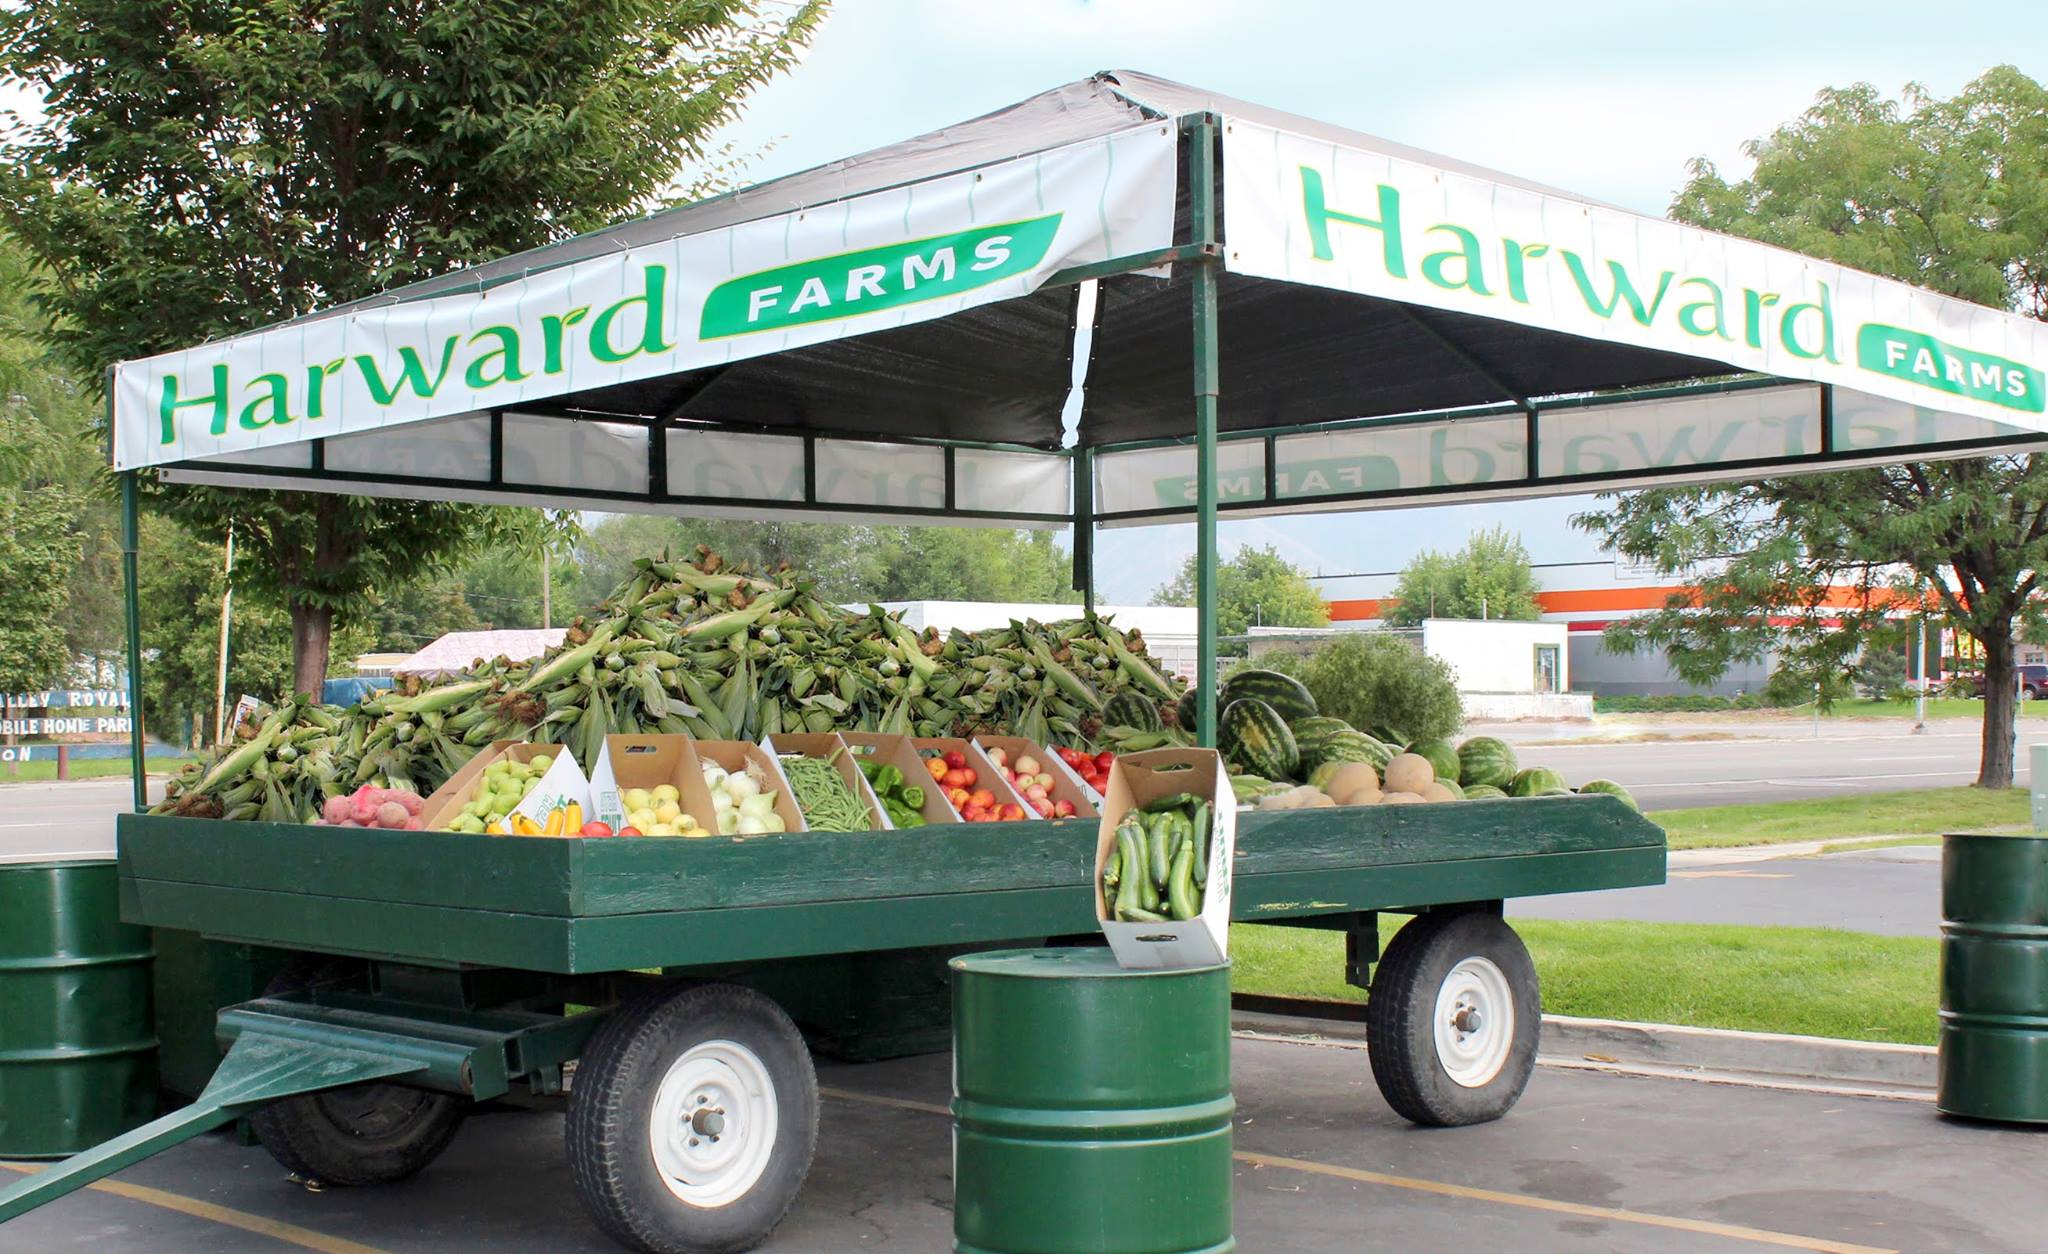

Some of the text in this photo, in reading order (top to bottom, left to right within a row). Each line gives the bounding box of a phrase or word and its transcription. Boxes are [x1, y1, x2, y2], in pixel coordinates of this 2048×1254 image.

[1299, 165, 2027, 397] Harward FARMS
[160, 235, 1014, 446] Harward FARMS
[0, 719, 38, 735] BILE
[70, 691, 132, 708] ROYAL
